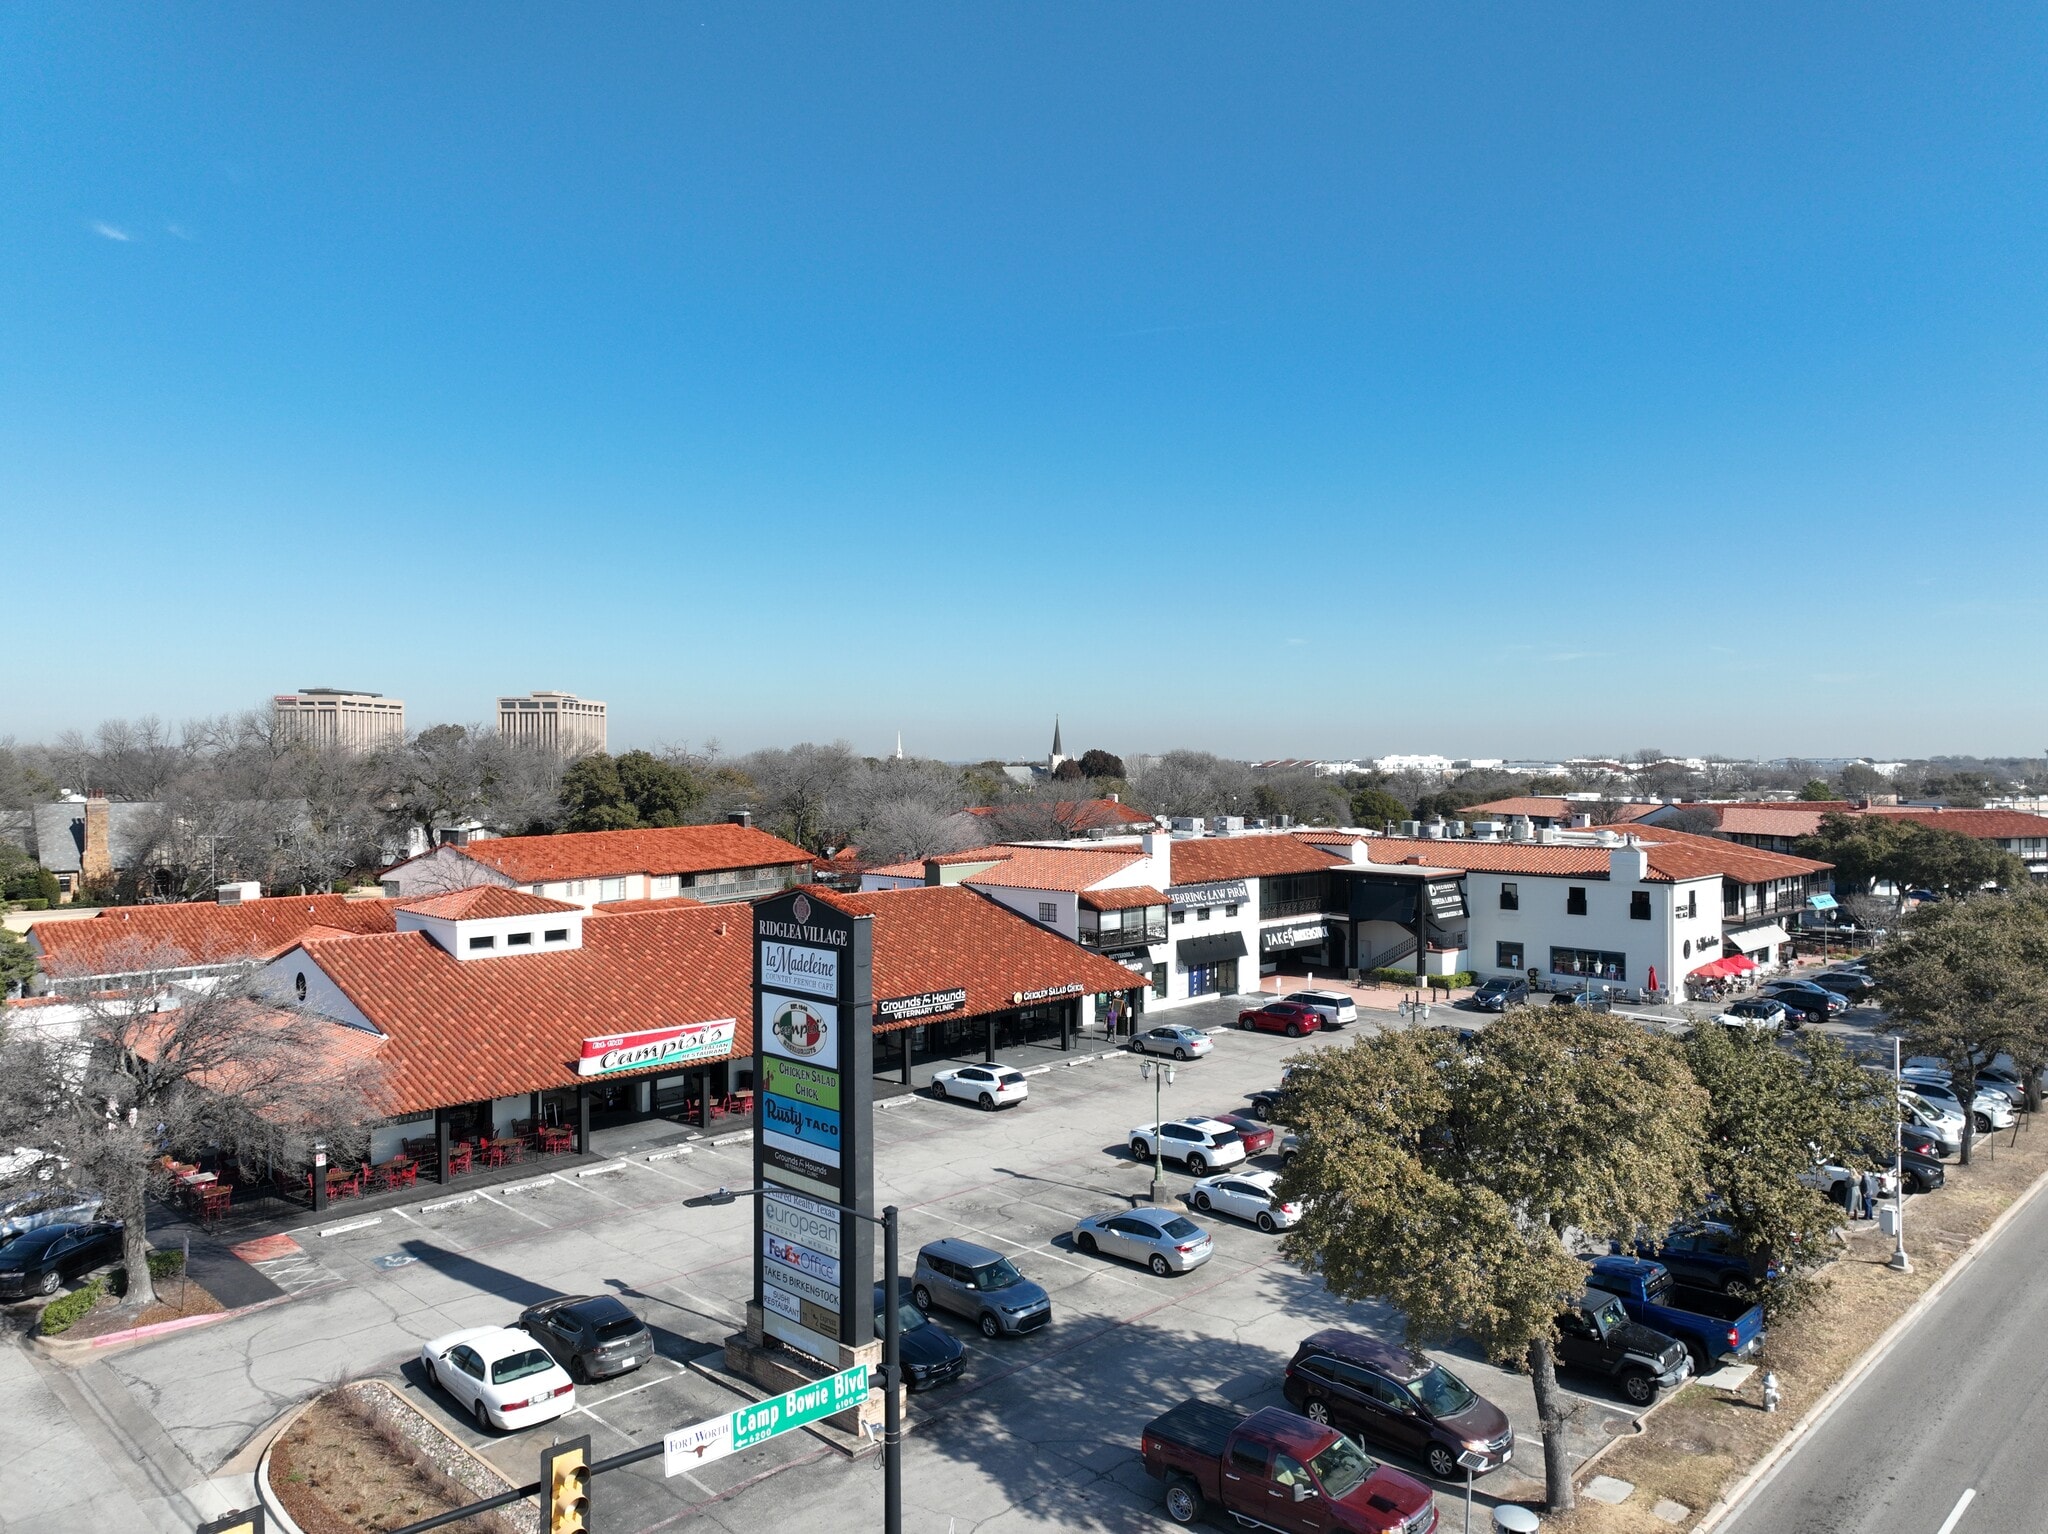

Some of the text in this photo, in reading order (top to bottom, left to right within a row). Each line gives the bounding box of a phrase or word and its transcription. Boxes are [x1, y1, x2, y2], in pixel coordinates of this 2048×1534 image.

[1168, 890, 1206, 904] HERRING
[1207, 889, 1226, 901] LAW
[1226, 886, 1247, 899] FIRM
[759, 920, 848, 946] RIDGLEA VILLAGE
[1265, 931, 1290, 946] TAKE
[765, 972, 793, 985] COUNTRY
[793, 977, 817, 988] FRENCH
[1048, 986, 1067, 997] SALAD
[881, 996, 921, 1012] Grounds
[932, 989, 966, 1004] Hounds
[893, 1003, 955, 1019] VETERINARY CLINIC
[600, 1026, 722, 1068] Campisi's
[681, 1048, 728, 1060] RESTAURANT
[779, 1062, 837, 1088] CHICKEN SALAD
[795, 1083, 819, 1101] CHICK
[765, 1098, 838, 1135] Rusty TACO
[774, 1151, 799, 1167] Grounds
[805, 1161, 828, 1176] Hounds
[793, 1194, 816, 1213] Realty
[816, 1202, 837, 1219] Texas
[766, 1203, 839, 1244] european
[769, 1238, 834, 1280] FedEx Office
[764, 1265, 840, 1306] TAKE 5 BIRKENSTOCK
[764, 1295, 800, 1319] RESTAURANT
[736, 1368, 866, 1435] Camp Bowie Blvd
[835, 1397, 855, 1411] 6100
[669, 1424, 729, 1453] FORT WORTH
[748, 1428, 772, 1443] 6200
